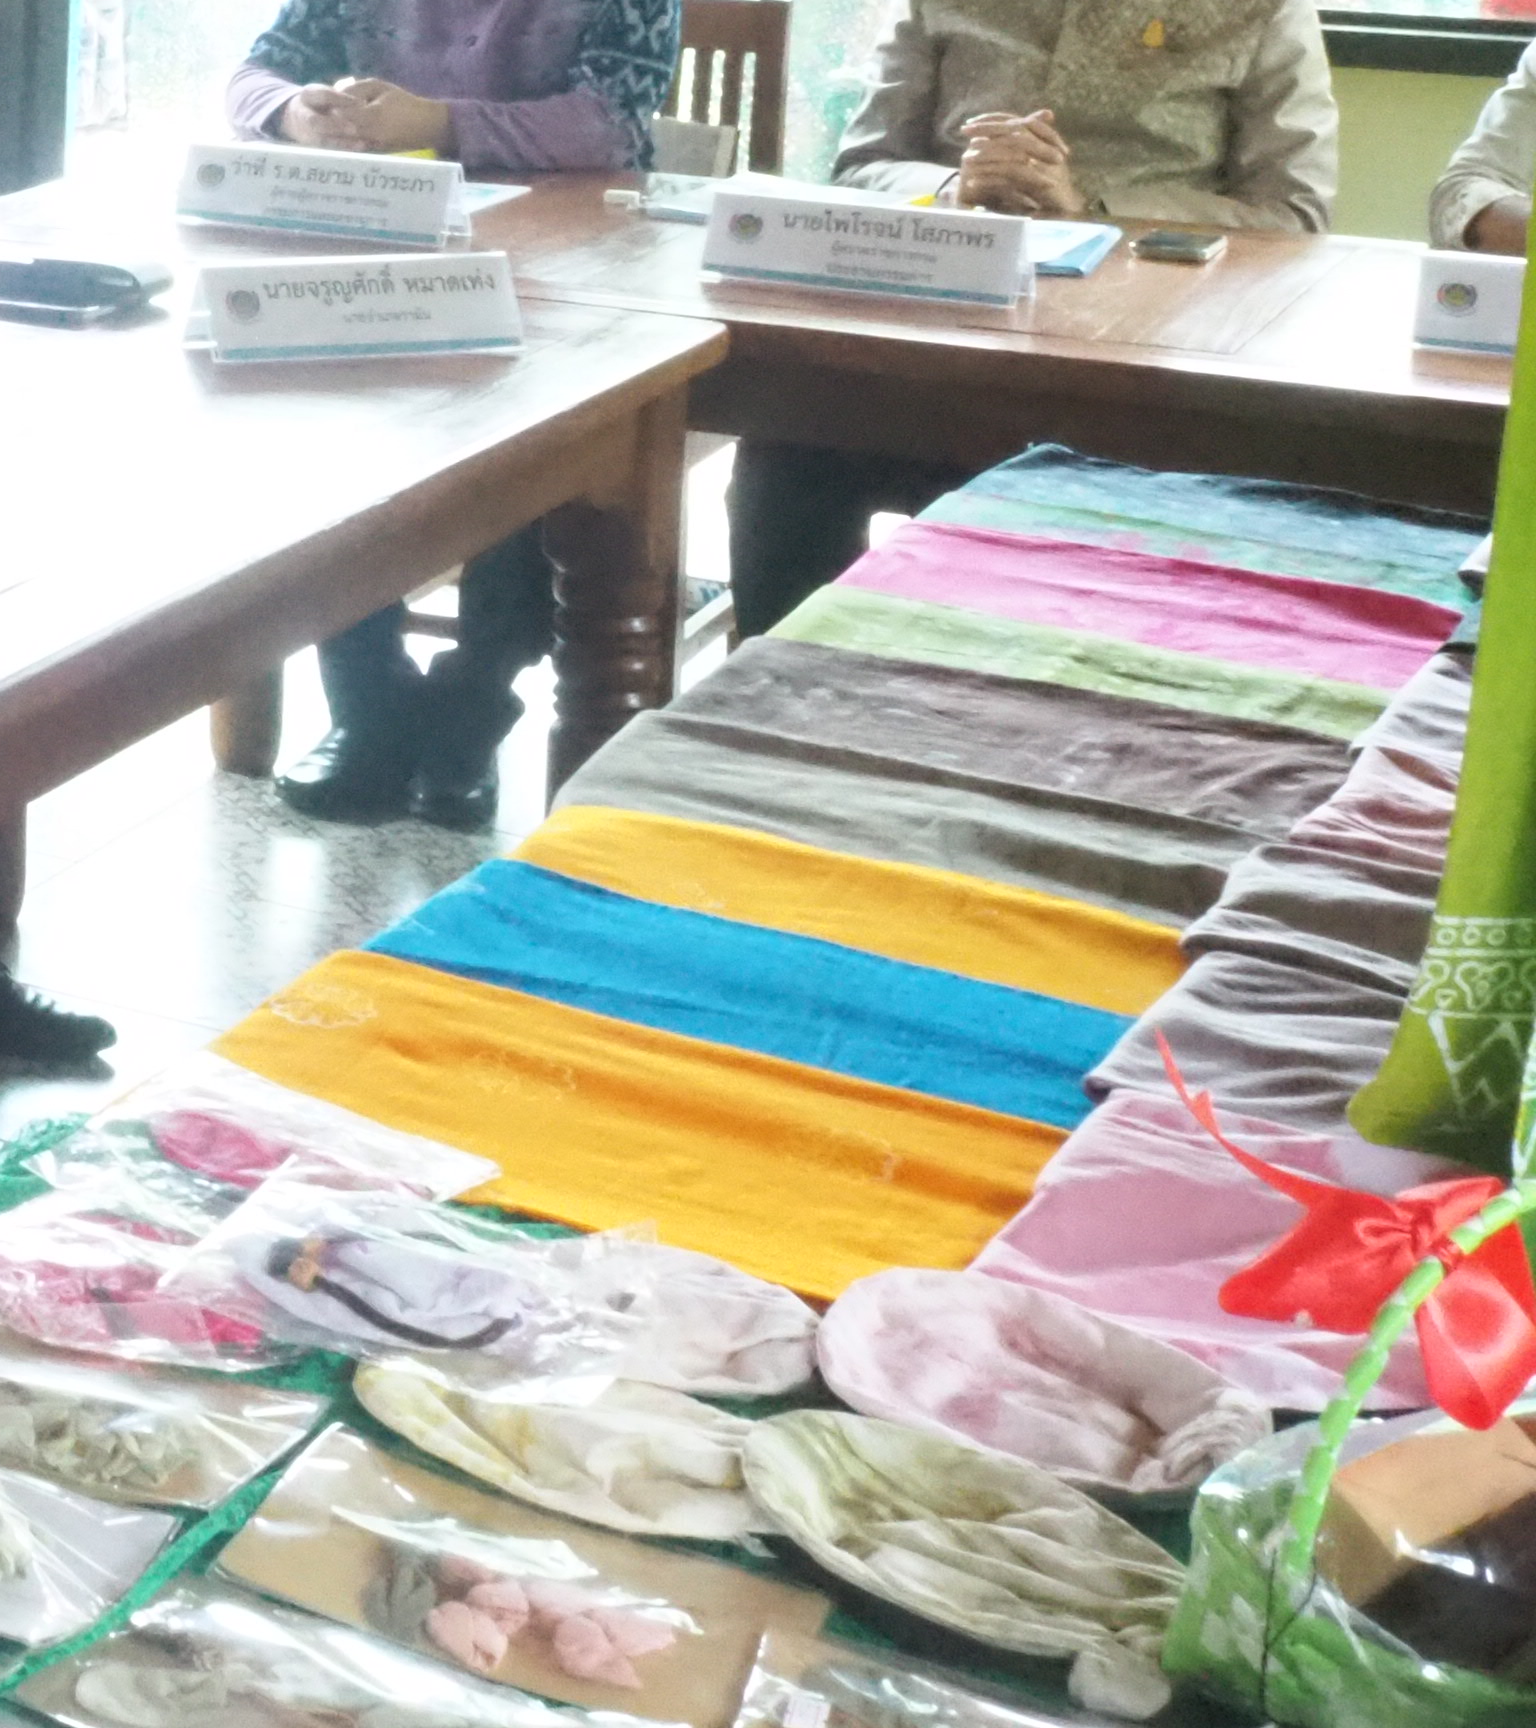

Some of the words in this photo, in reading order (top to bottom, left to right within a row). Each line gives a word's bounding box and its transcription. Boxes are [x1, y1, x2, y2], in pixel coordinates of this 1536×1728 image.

[783, 208, 904, 240] นายไพโรจน์
[912, 217, 997, 249] โสภาพร
[263, 263, 395, 306] นายจรูญศักดิ์
[403, 267, 496, 293] หมาดเท่ง
